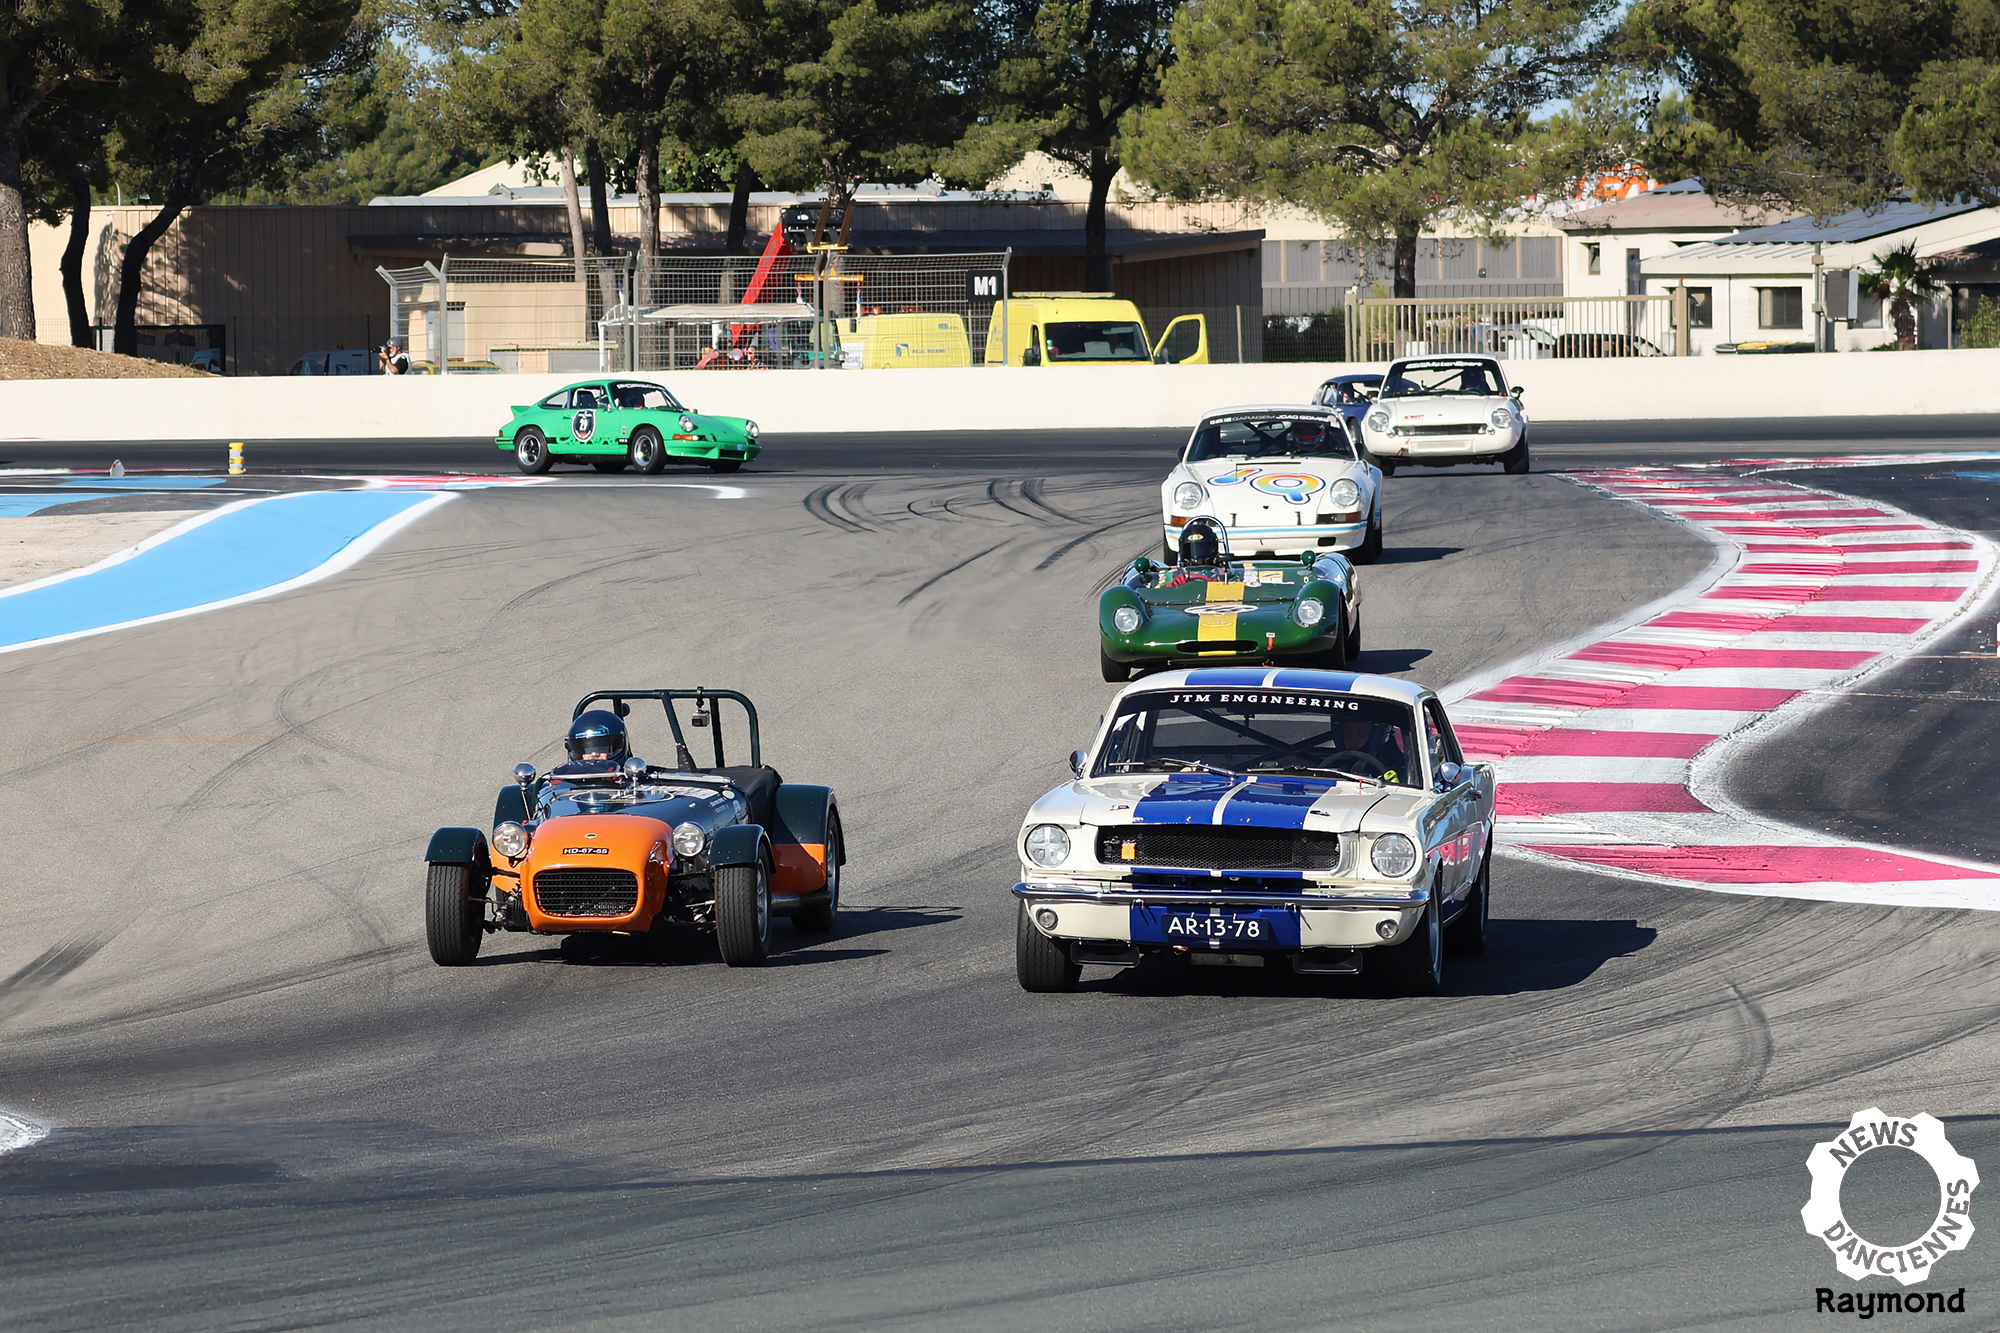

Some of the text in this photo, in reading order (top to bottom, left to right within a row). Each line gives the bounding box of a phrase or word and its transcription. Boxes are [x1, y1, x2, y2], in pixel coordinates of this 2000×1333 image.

[974, 276, 997, 296] M1
[1170, 694, 1359, 711] JTM ENGINEERING
[1167, 916, 1260, 938] AR-13-78
